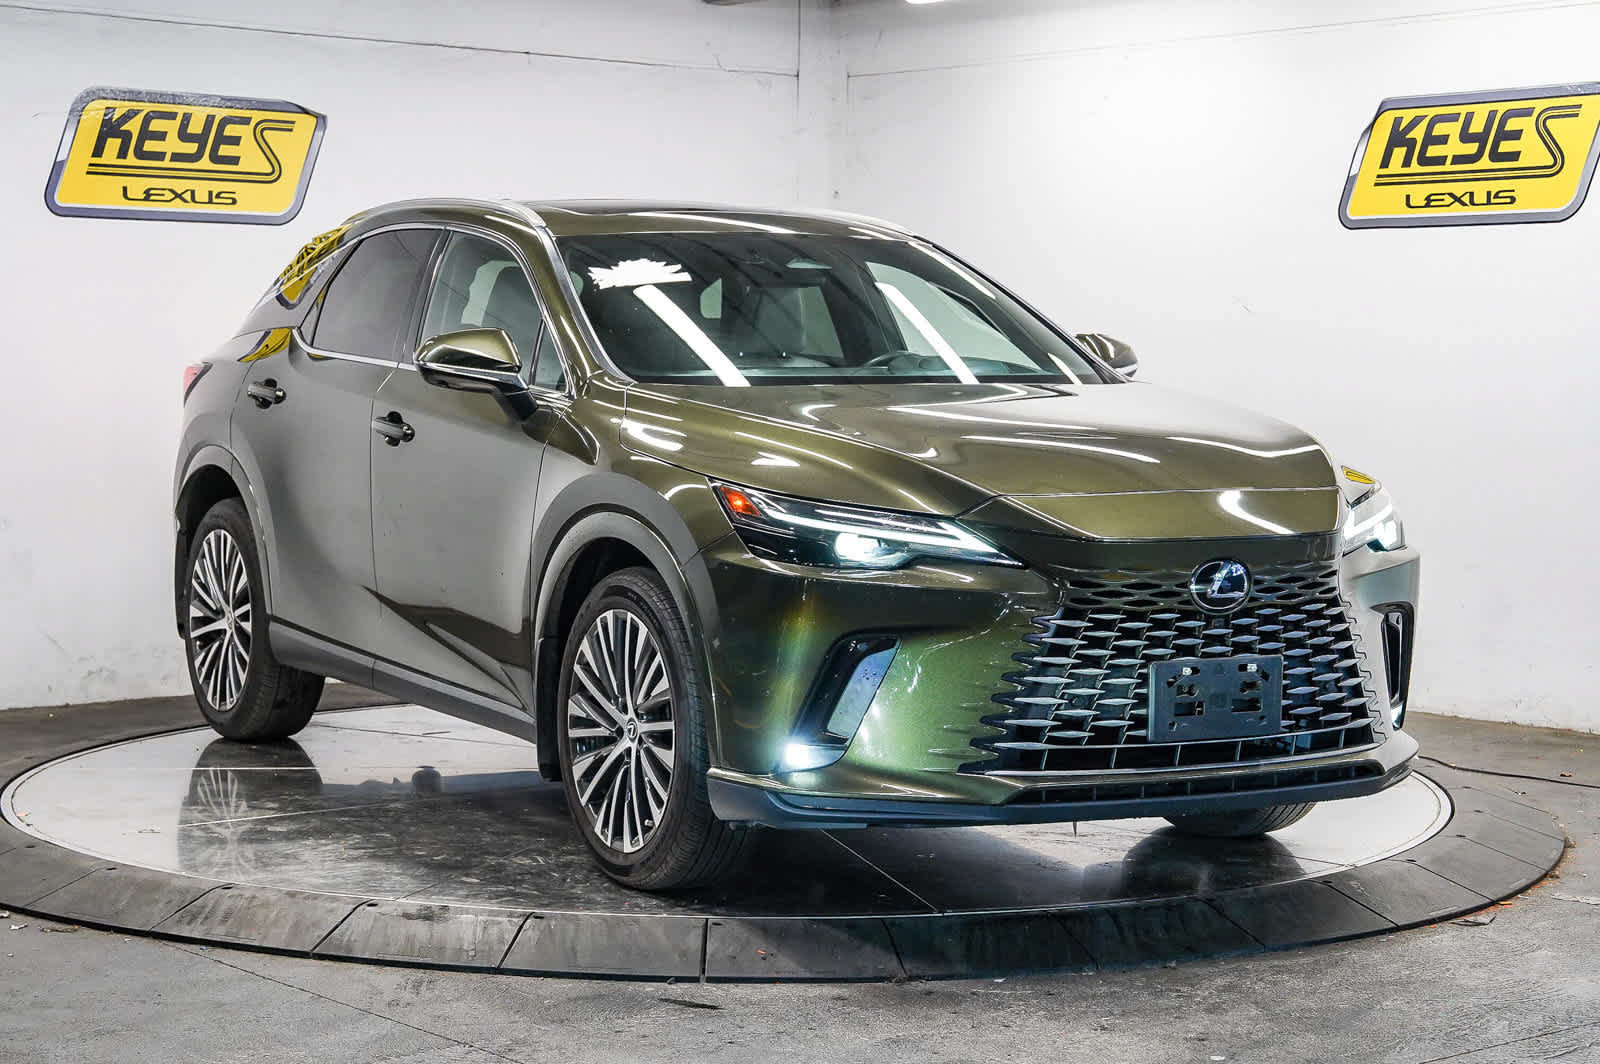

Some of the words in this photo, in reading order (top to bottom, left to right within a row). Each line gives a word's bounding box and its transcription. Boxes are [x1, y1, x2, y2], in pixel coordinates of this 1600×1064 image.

[86, 106, 296, 184] KEYES
[1374, 104, 1582, 186] KEYES
[122, 185, 238, 206] LEXUS
[1405, 189, 1517, 209] LEXUS
